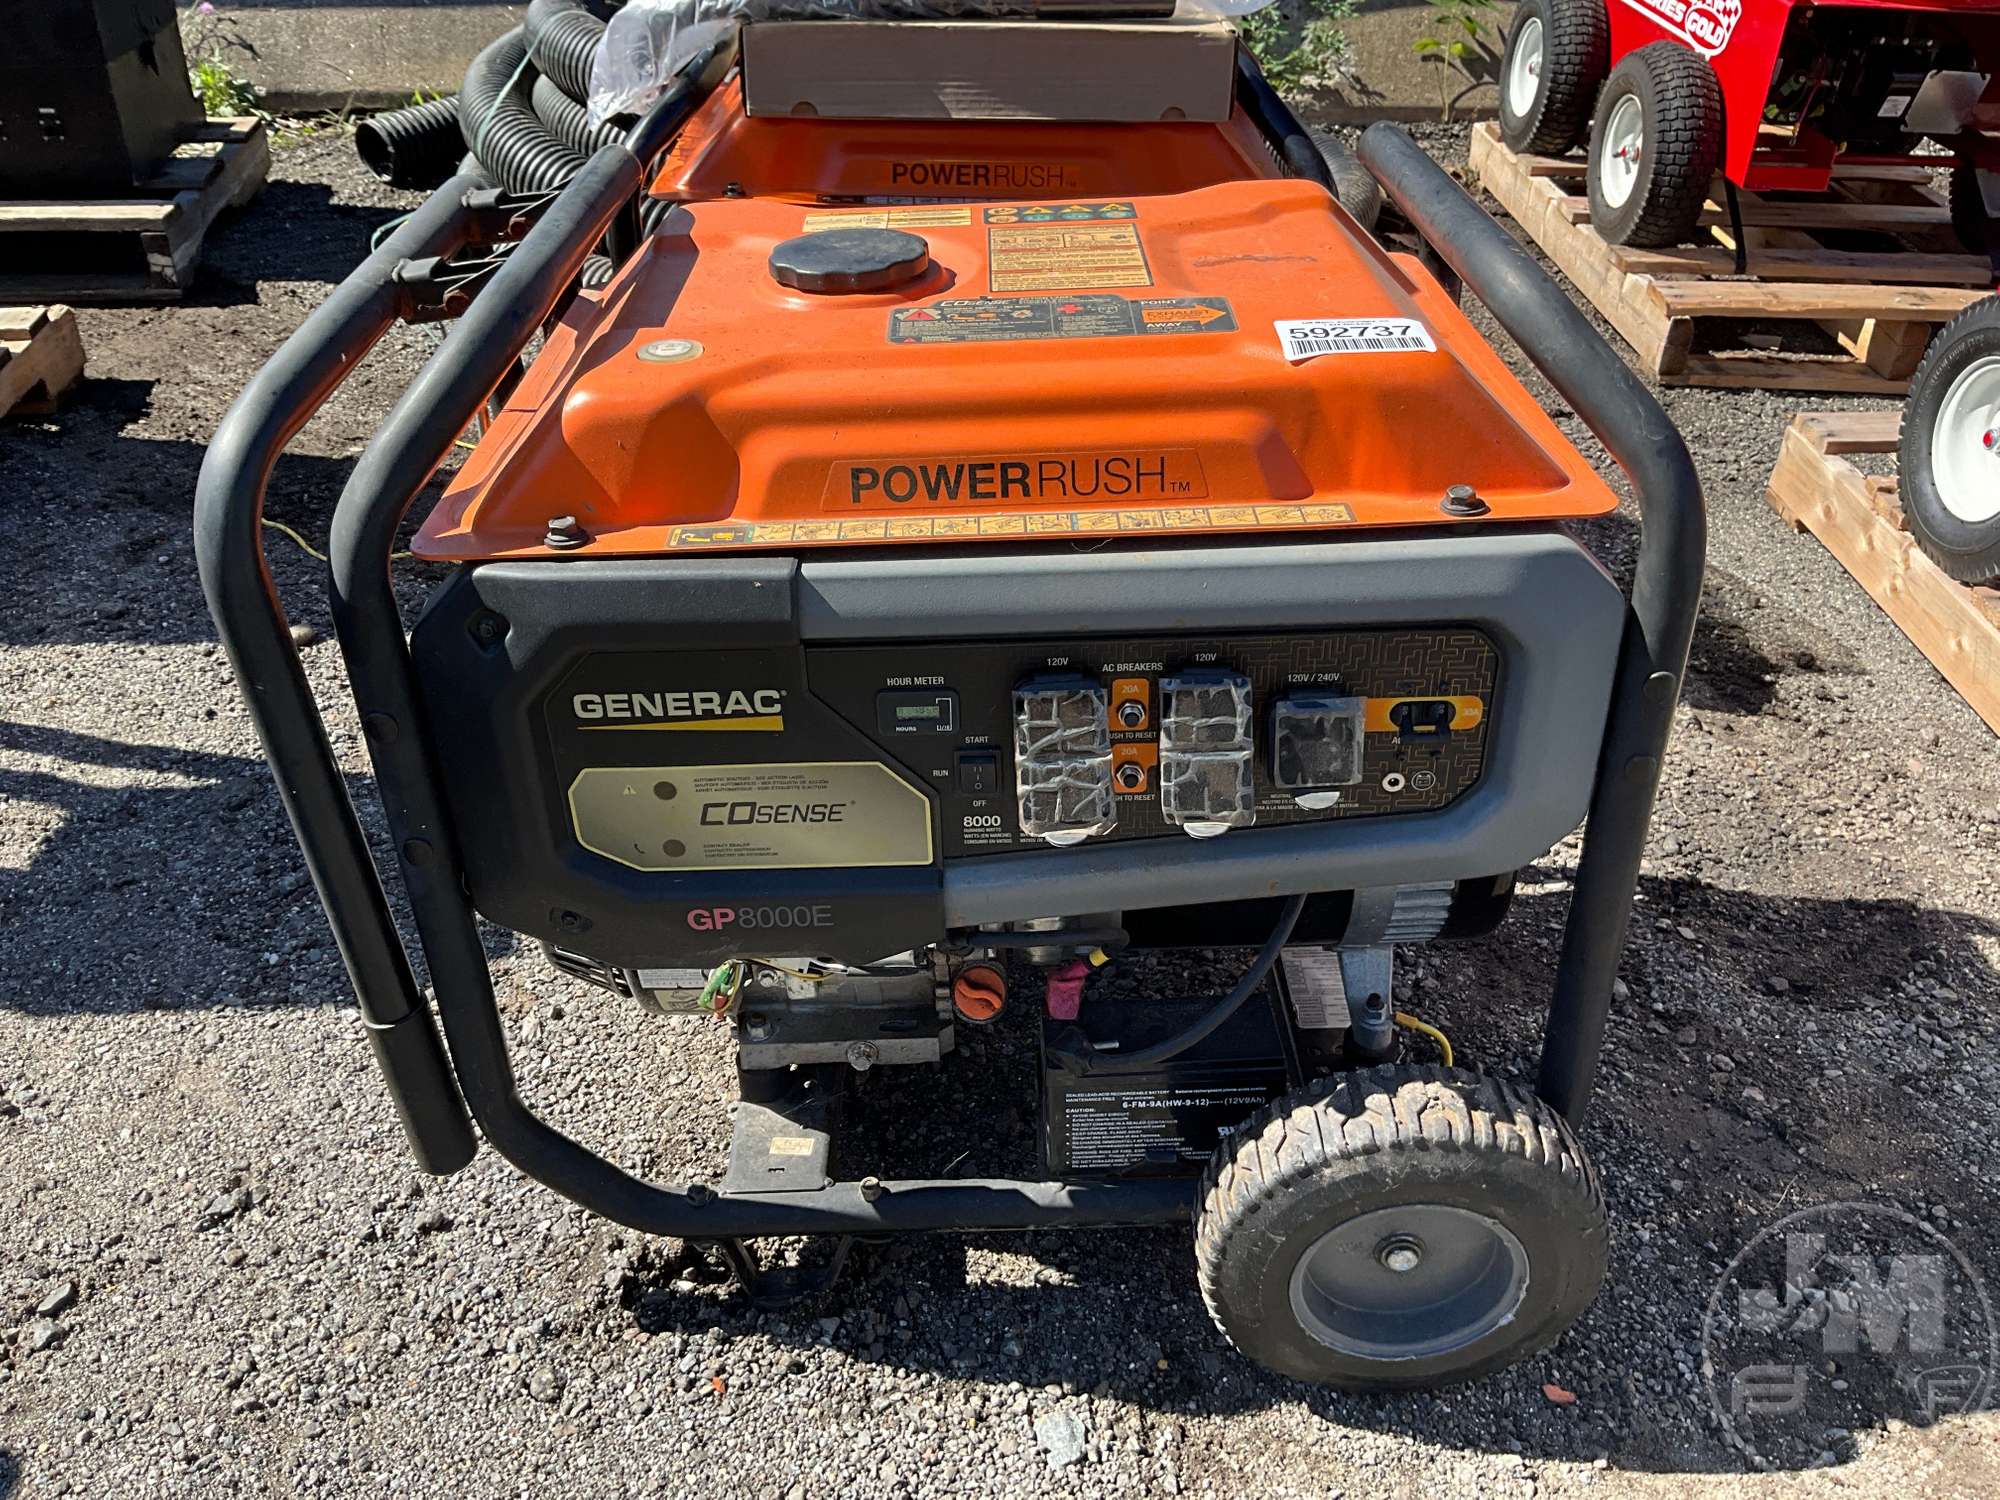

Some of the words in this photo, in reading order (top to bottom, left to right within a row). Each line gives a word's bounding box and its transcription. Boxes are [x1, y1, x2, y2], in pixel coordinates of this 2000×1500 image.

[1687, 11, 1725, 47] GOLD
[891, 163, 1064, 188] POWERRUSH
[1288, 325, 1411, 339] 592737
[850, 456, 1165, 504] POWERRUSH
[1046, 657, 1069, 666] 120V
[1195, 653, 1217, 662] 120V
[1102, 663, 1115, 672] AC
[1116, 662, 1163, 672] BREAKERS
[886, 677, 912, 686] HOUR
[914, 676, 945, 685] METER
[1287, 673, 1309, 683] 120V
[1317, 672, 1340, 682] 240V
[1121, 684, 1140, 693] 20A
[573, 689, 782, 719] GENERAC
[965, 736, 989, 744] START
[1136, 731, 1157, 739] RESET
[1120, 747, 1138, 756] 20A
[932, 769, 949, 777] RUN
[1134, 793, 1156, 801] RESET
[963, 815, 1001, 827] 8000
[687, 905, 835, 931] GP8000E
